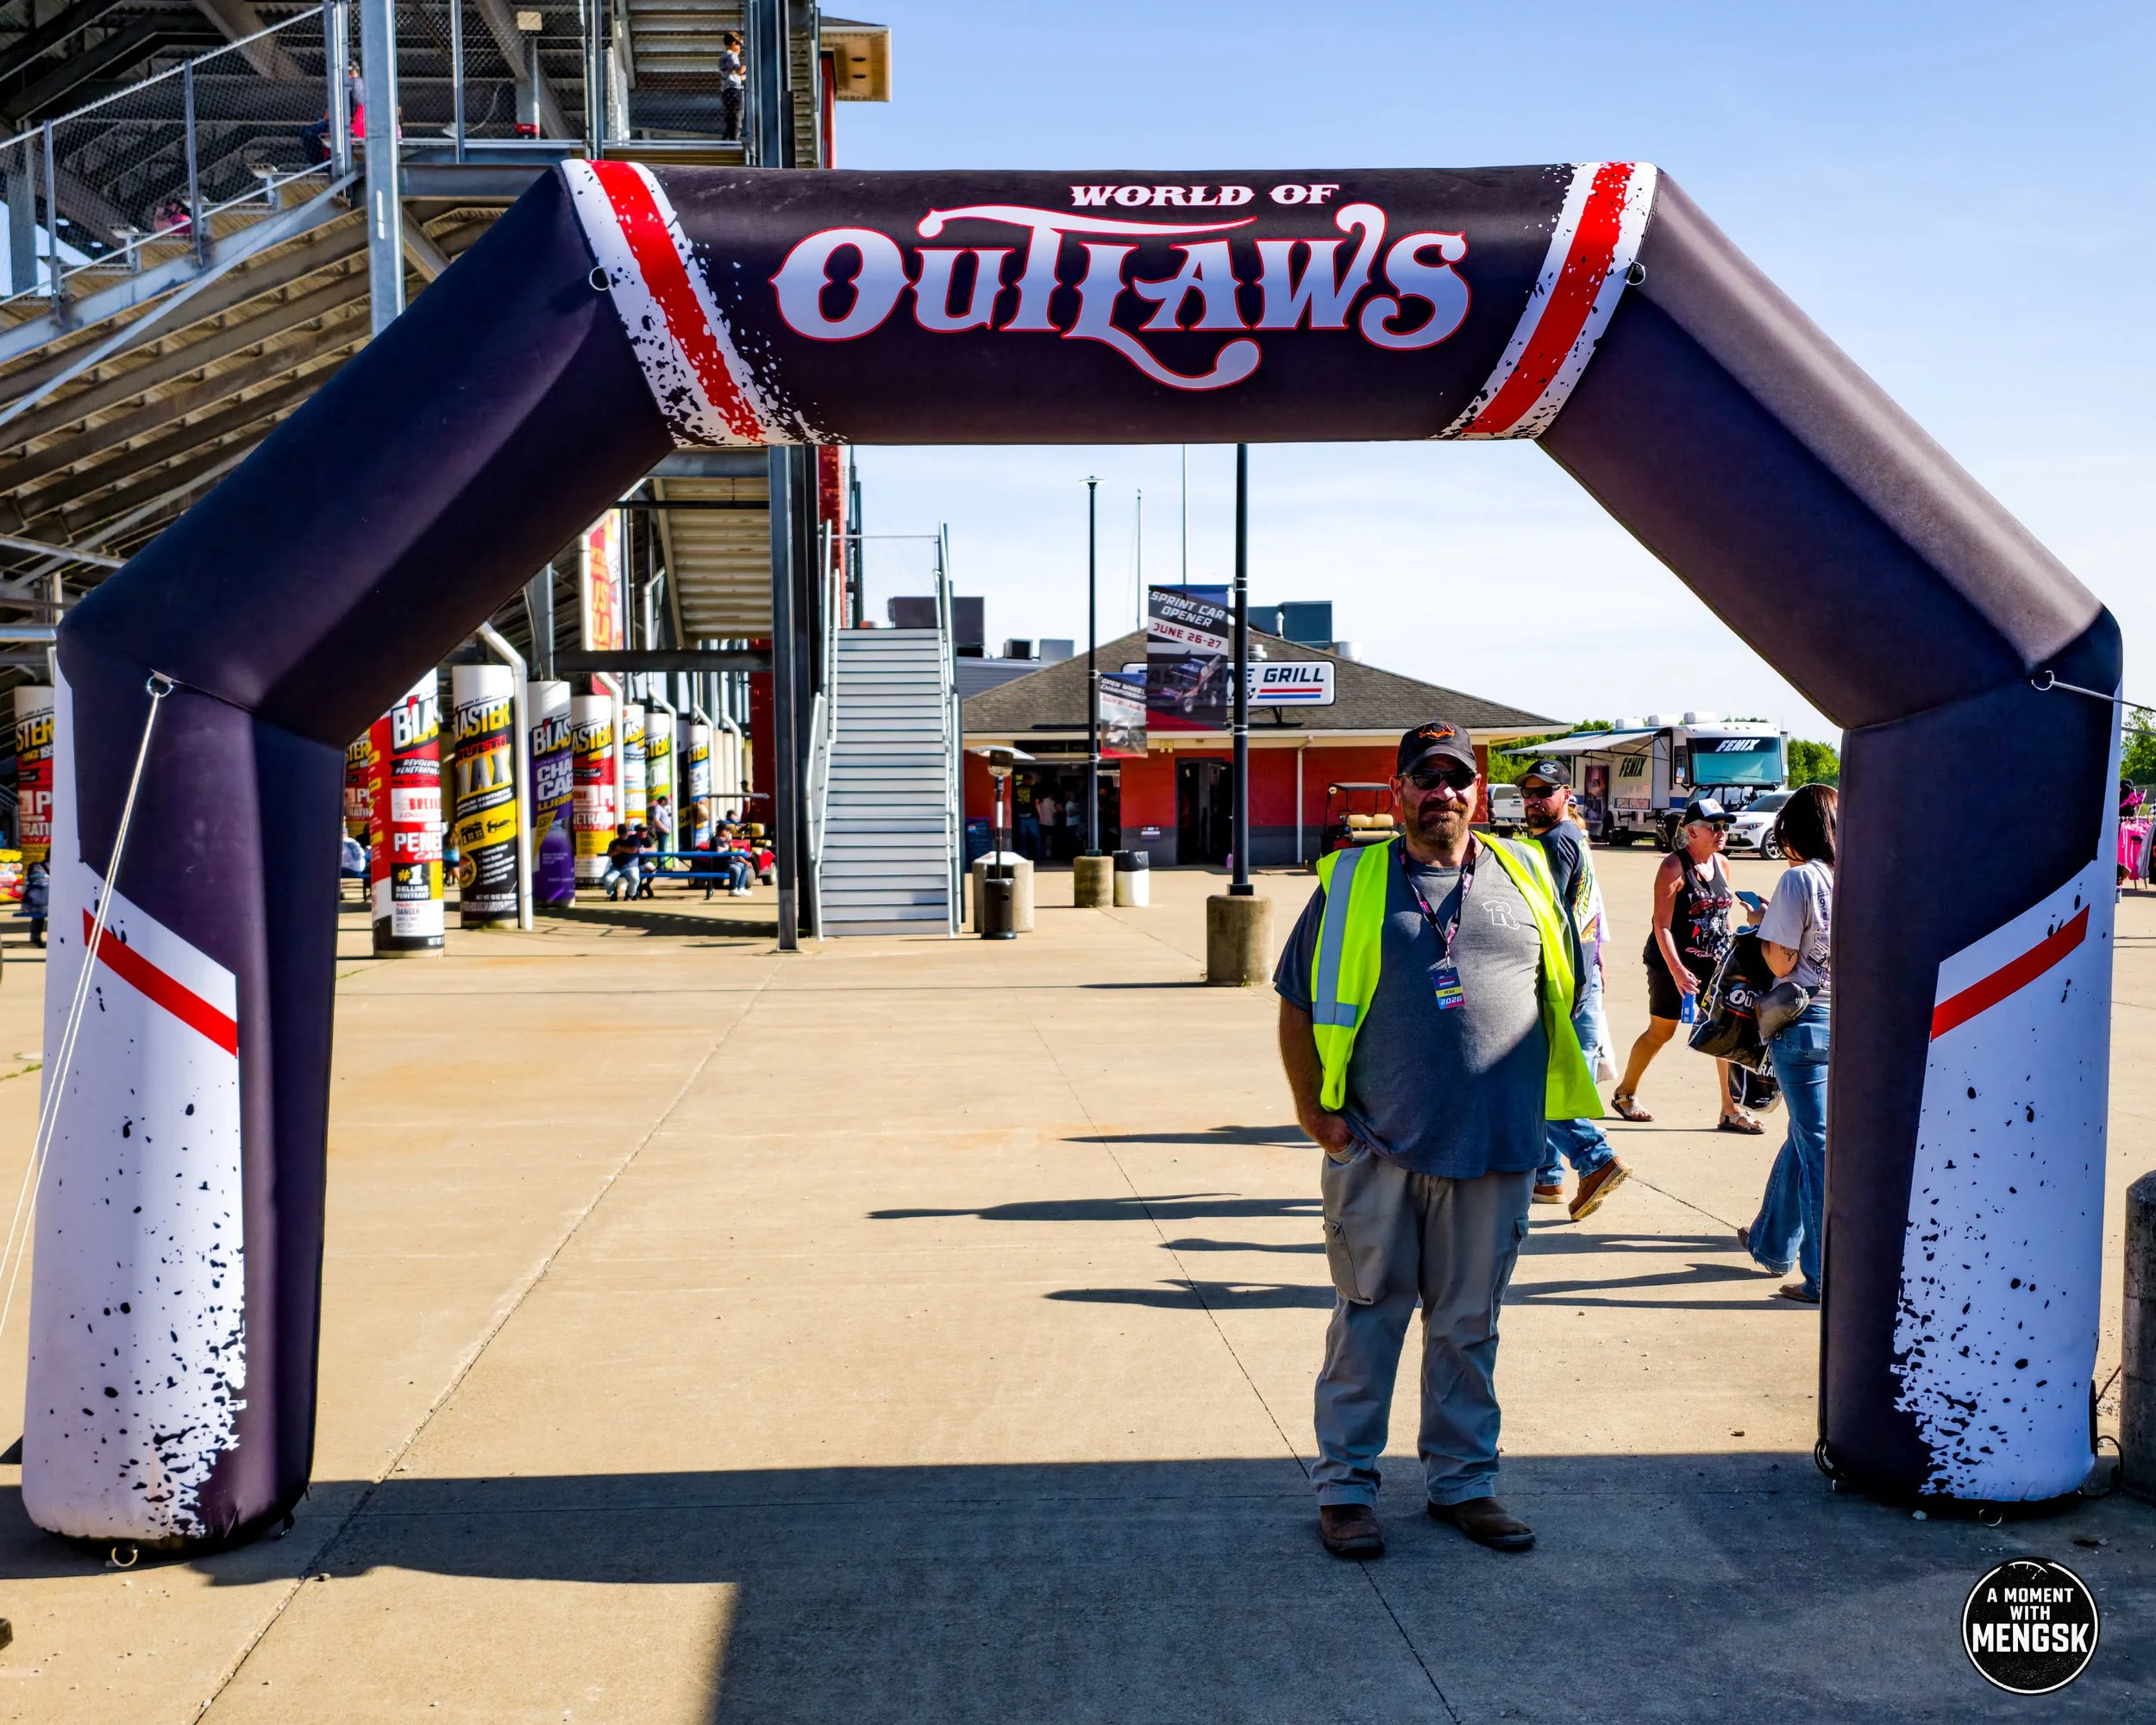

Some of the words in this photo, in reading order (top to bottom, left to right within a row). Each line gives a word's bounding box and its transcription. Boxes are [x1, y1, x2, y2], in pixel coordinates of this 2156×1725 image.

[1069, 185, 1256, 206] WORLD
[1268, 183, 1340, 205] OF
[1150, 591, 1197, 611] SPRINT
[1198, 605, 1225, 619] CAR
[1161, 605, 1213, 627] OPENER
[1153, 622, 1184, 638] JUNE
[1187, 632, 1222, 649] 26-27
[1263, 668, 1325, 683] GRILL
[1715, 739, 1760, 752] FENIX
[1619, 756, 1648, 778] FENIX
[1440, 995, 1463, 1006] 2026
